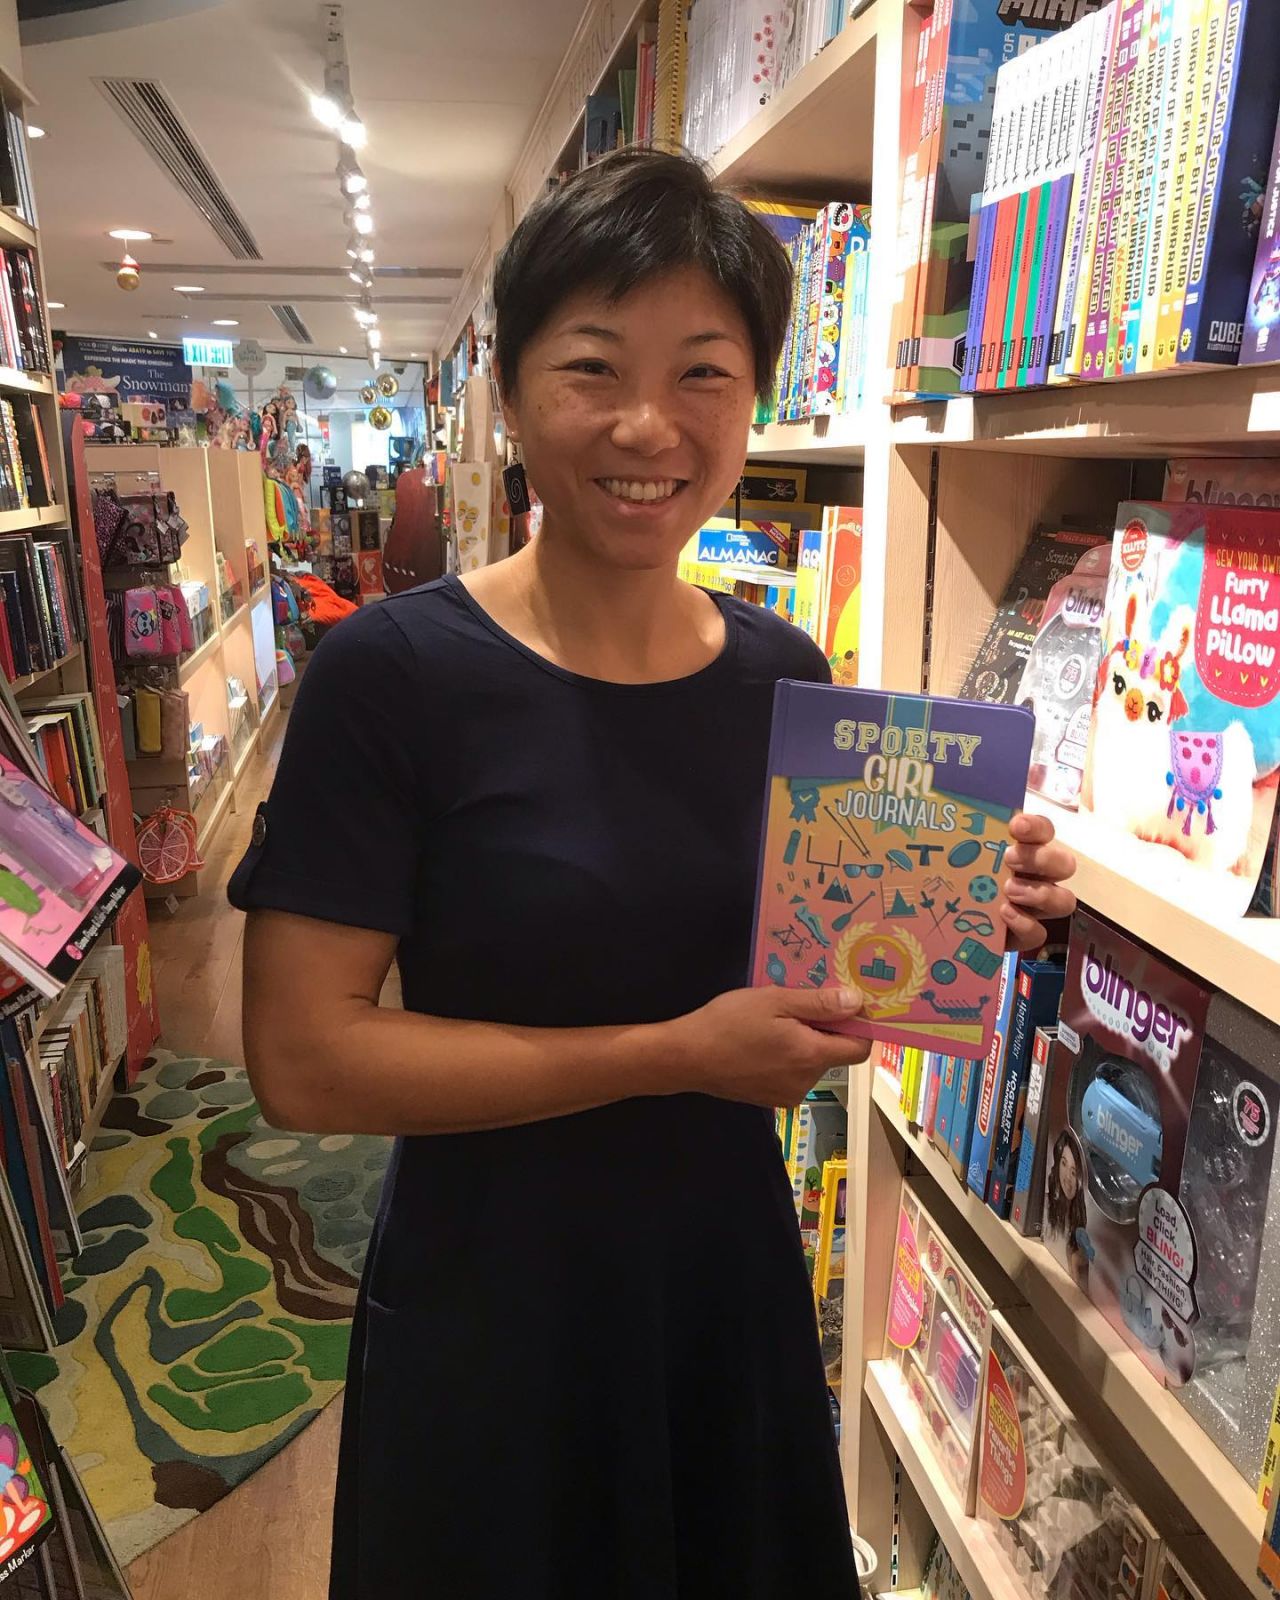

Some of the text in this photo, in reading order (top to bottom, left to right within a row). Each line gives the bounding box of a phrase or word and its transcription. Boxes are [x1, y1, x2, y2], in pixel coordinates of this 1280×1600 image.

[1185, 27, 1200, 79] DIARY
[1203, 17, 1220, 76] DIARY
[1223, 3, 1240, 65] DIARY
[1142, 52, 1157, 106] DIARY
[1152, 45, 1167, 101] DIARY
[1167, 37, 1182, 95] DIARY
[1219, 69, 1231, 93] OF
[1086, 55, 1108, 151] MINECRAFT
[1108, 77, 1124, 134] TALES
[1120, 68, 1136, 128] TALES
[1131, 68, 1147, 124] DIARY
[1149, 105, 1160, 130] OF
[1164, 97, 1176, 122] OF
[1182, 83, 1194, 109] OF
[1199, 81, 1212, 106] OF
[1117, 134, 1129, 158] OF
[1127, 127, 1140, 152] OF
[1139, 110, 1150, 134] OF
[1080, 157, 1092, 193] NIGHT
[1105, 139, 1117, 164] OF
[1187, 143, 1203, 198] 8-BIT
[1206, 131, 1222, 188] 8-BIT
[1129, 169, 1144, 218] 8-BIT
[1139, 163, 1153, 217] 8-BIT
[1154, 159, 1169, 208] 8-BIT
[1170, 151, 1186, 206] 8-BIT
[1073, 218, 1083, 241] THE
[1094, 200, 1110, 251] 8-BIT
[1107, 193, 1122, 243] 8-BIT
[1116, 188, 1133, 239] 8-BIT
[1193, 192, 1213, 282] WARRIOR
[1120, 222, 1138, 302] WARRIOR
[1129, 219, 1147, 299] WARRIOR
[1144, 214, 1163, 296] WARRIOR
[1160, 209, 1179, 293] WARRIOR
[1175, 201, 1196, 289] WARRIOR
[1087, 255, 1103, 314] KITTEN
[1099, 248, 1116, 313] KITTEN
[84, 355, 111, 363] EXPERIENCE
[147, 368, 164, 379] The
[184, 343, 207, 362] EXIT
[122, 375, 192, 393] Snowman
[699, 546, 777, 564] ALMANAC
[1045, 549, 1078, 566] Scratch
[1216, 549, 1234, 568] SEW
[1237, 551, 1258, 572] YOUR
[834, 719, 982, 766] SPORTY
[864, 753, 937, 799] GIRL
[838, 790, 957, 832] JOURNALS
[1086, 943, 1188, 1051] blinger
[1011, 998, 1028, 1059] Harry Potter
[1036, 1038, 1044, 1060] LEGO
[979, 1037, 999, 1128] DRIVE-THRU
[1001, 1070, 1018, 1142] HOGWARTS
[1030, 1074, 1042, 1115] STAR
[1097, 1104, 1144, 1156] blinger
[1244, 1095, 1260, 1122] 75
[1153, 1216, 1177, 1249] Click,
[1155, 1199, 1178, 1233] Load,
[1146, 1225, 1185, 1272] BLING!
[1142, 1265, 1183, 1311] ANYTHING!
